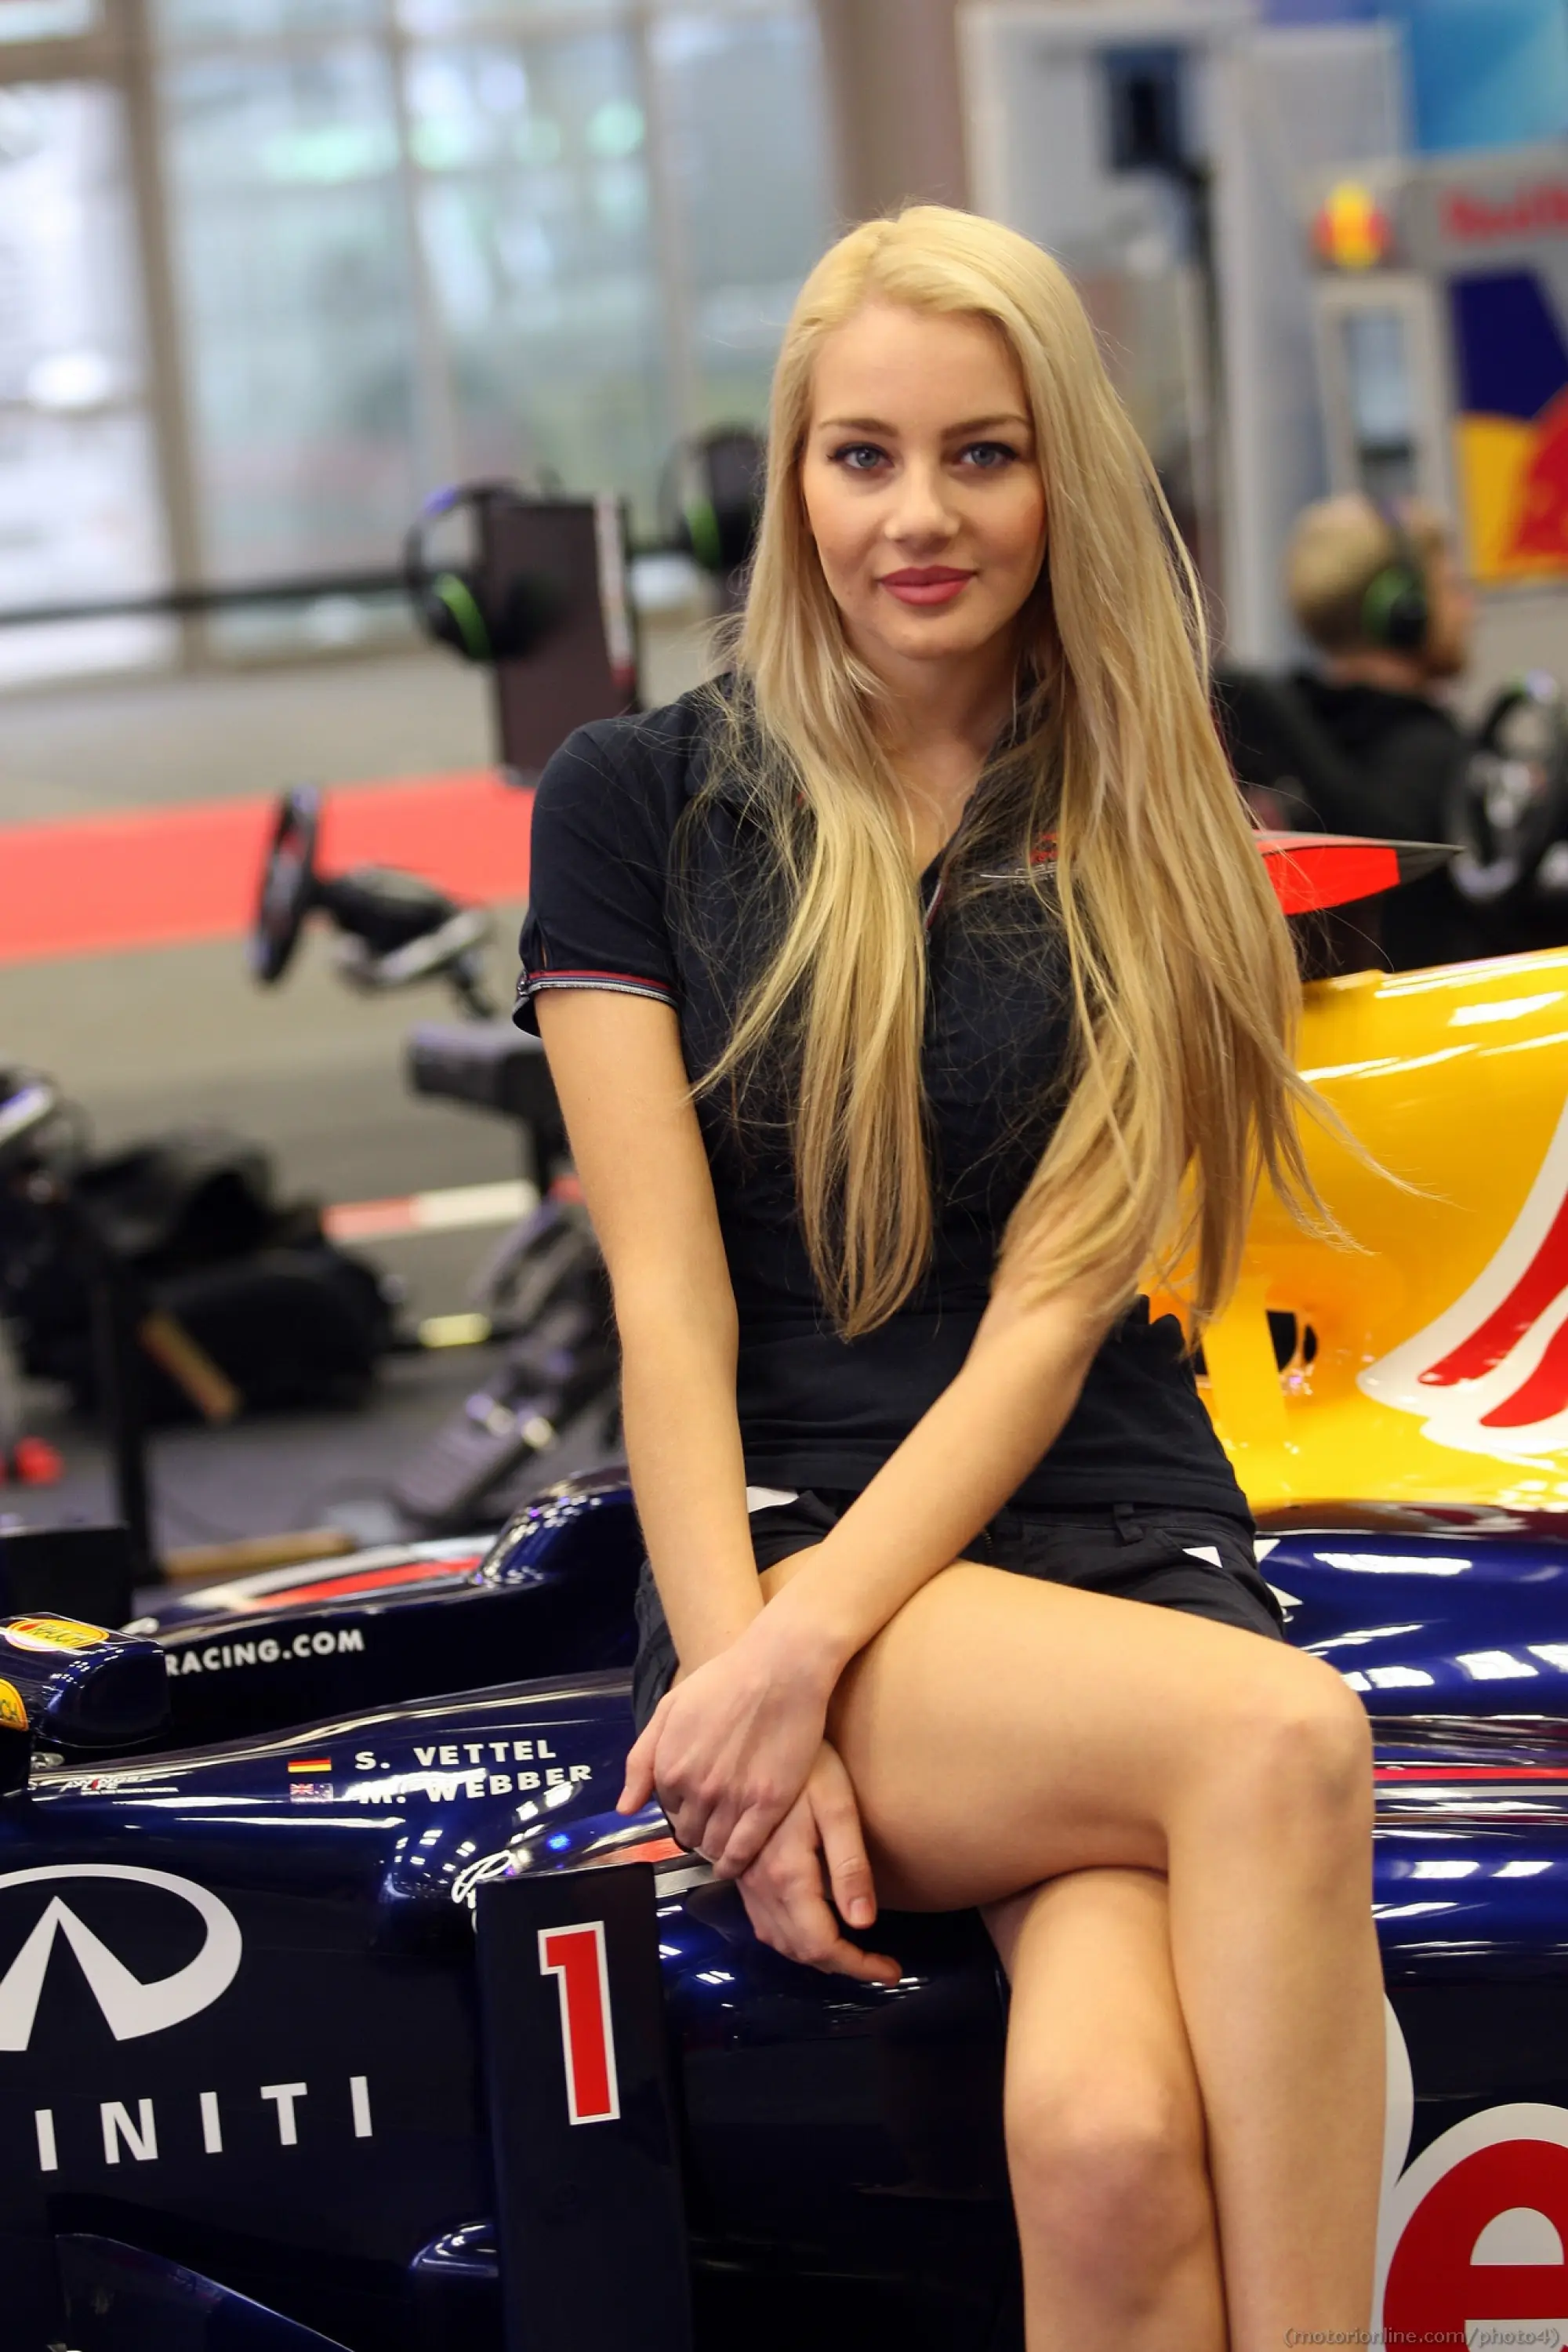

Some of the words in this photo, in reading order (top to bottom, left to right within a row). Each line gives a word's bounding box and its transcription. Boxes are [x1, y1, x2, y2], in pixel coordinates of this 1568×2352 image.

[165, 1629, 365, 1676] RACING.COM
[354, 1751, 390, 1769] S.
[413, 1740, 557, 1766] VETTEL
[423, 1765, 593, 1802] WEBBER
[537, 1921, 621, 2125] 1
